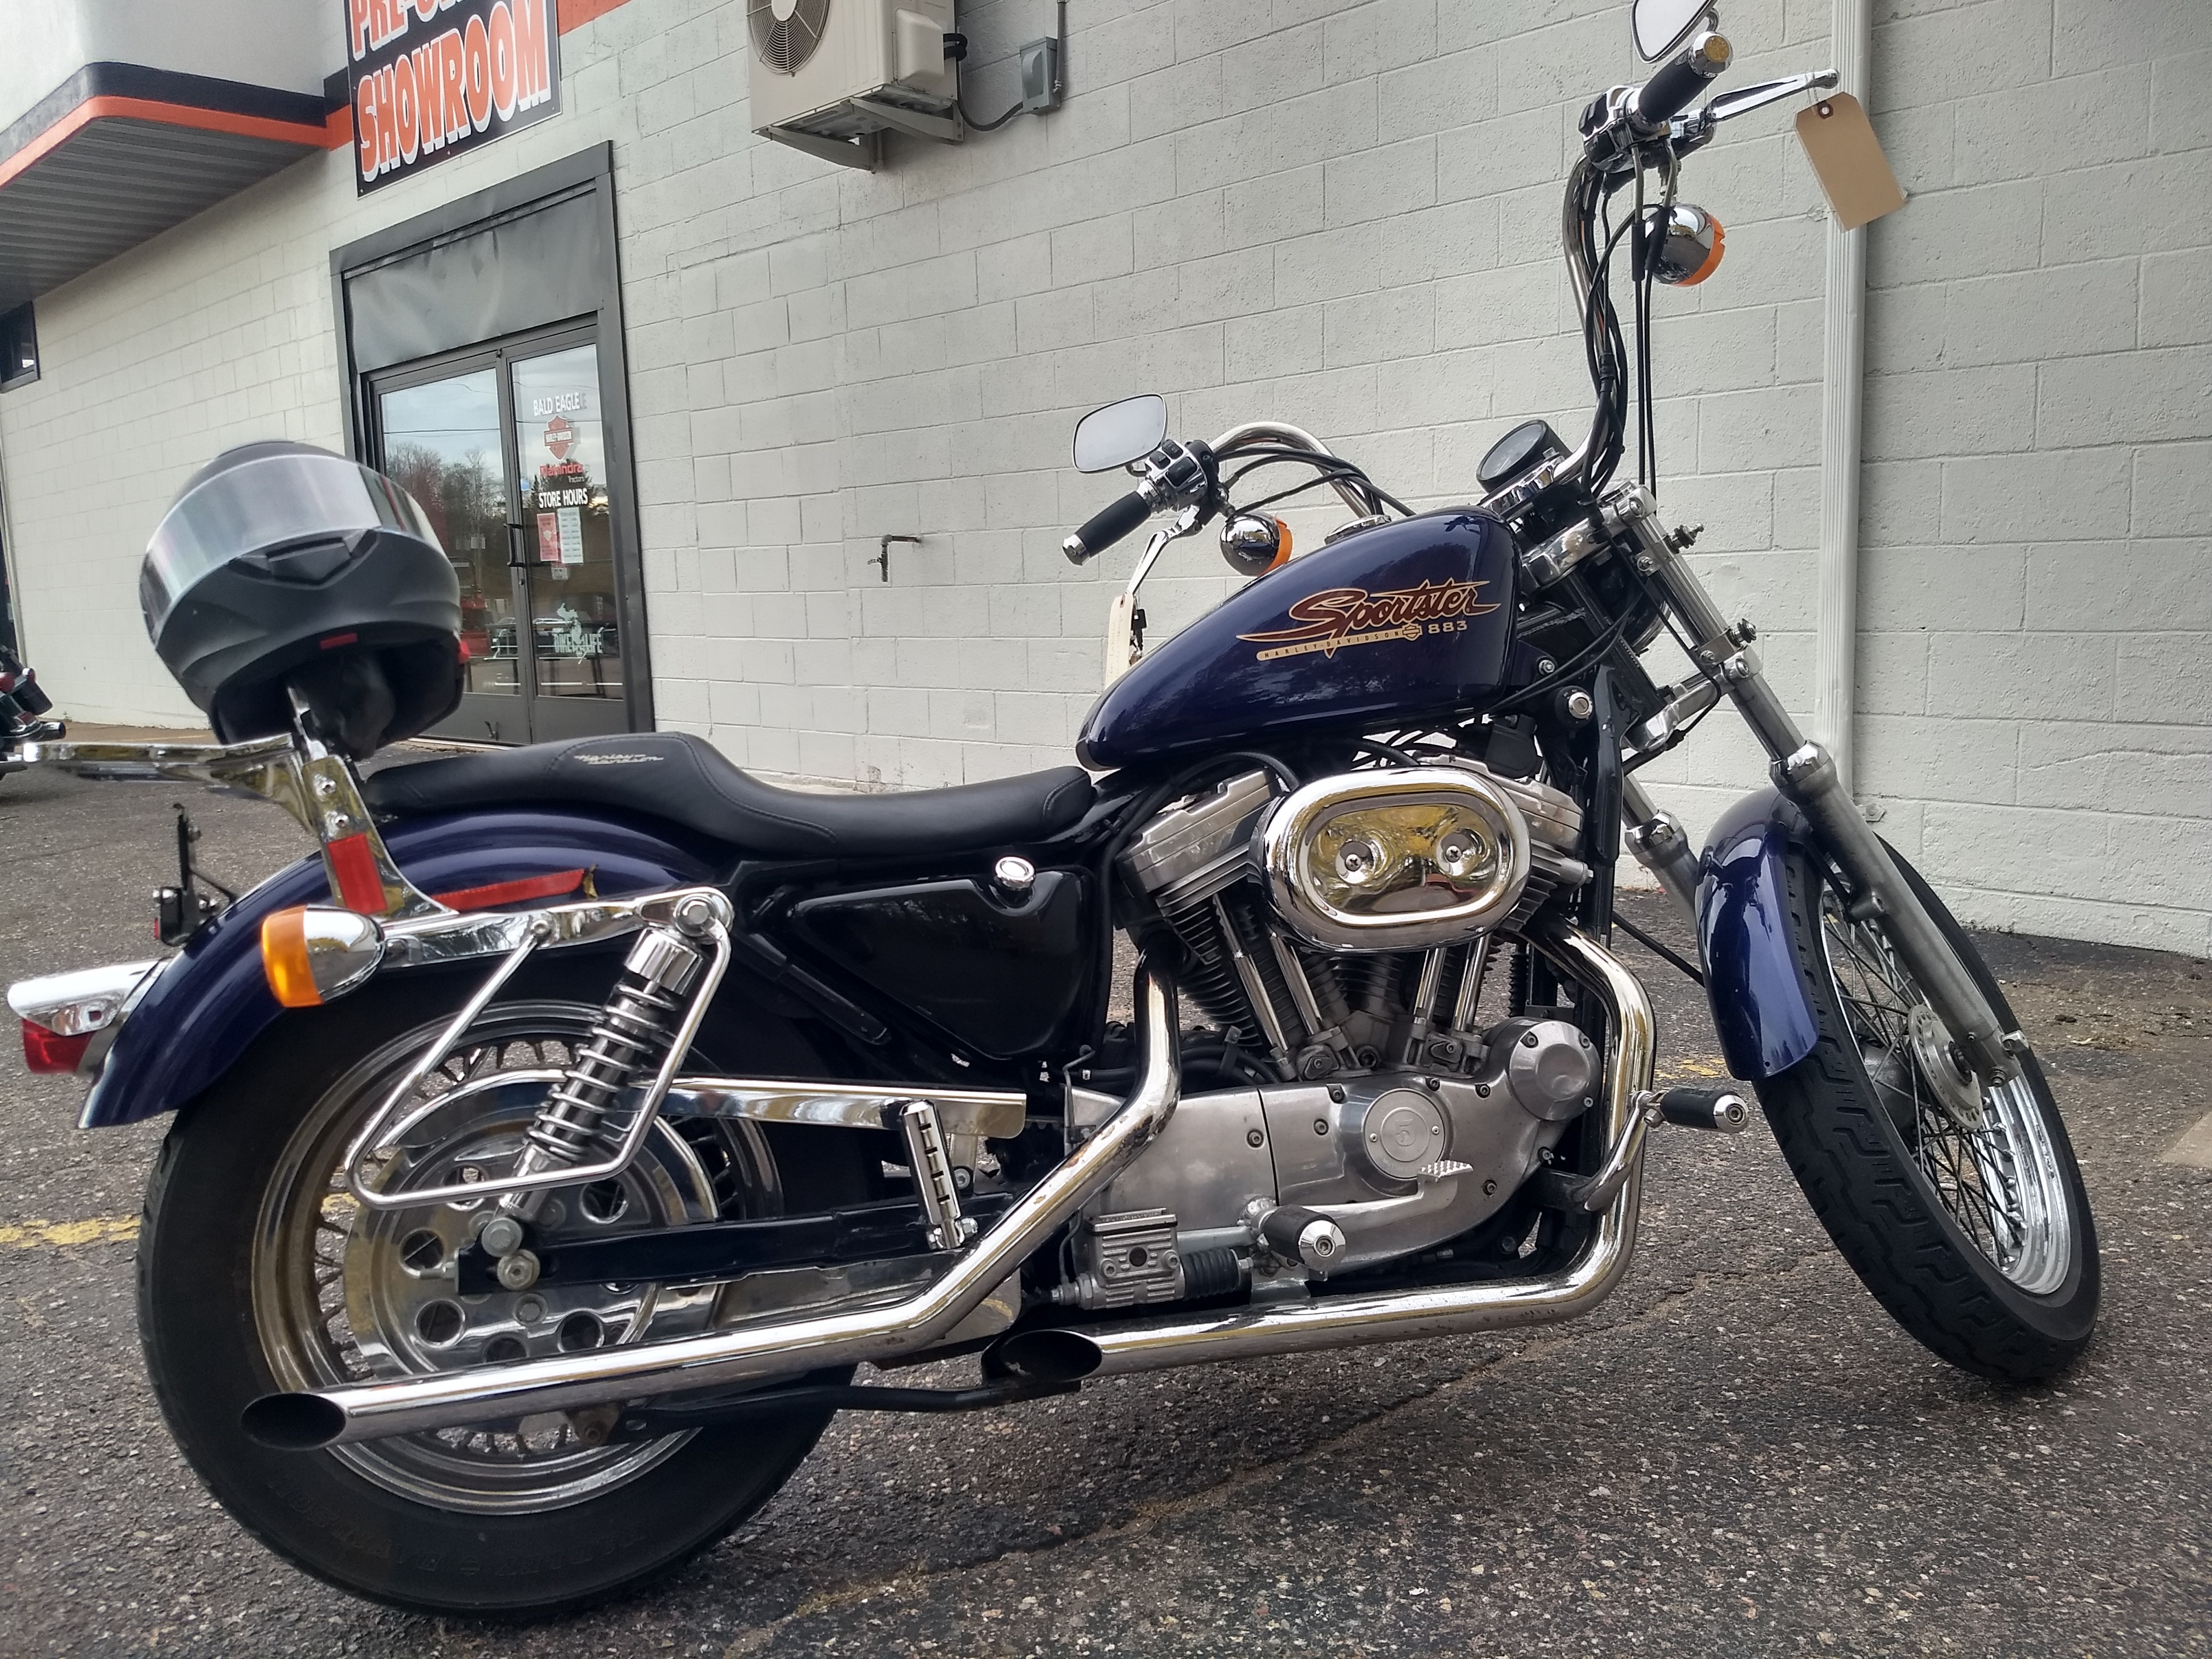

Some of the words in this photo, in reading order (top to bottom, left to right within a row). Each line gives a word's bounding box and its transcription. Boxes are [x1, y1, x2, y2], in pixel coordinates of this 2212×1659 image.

[358, 0, 551, 182] SHOWROOM
[533, 397, 553, 416] BALD
[555, 392, 580, 413] EAGLE
[539, 491, 561, 508] STORE
[563, 488, 588, 506] HOURS
[1236, 578, 1502, 659] Sportster
[1264, 630, 1400, 658] HARLEY-DAVIDSON
[1427, 620, 1468, 634] 883
